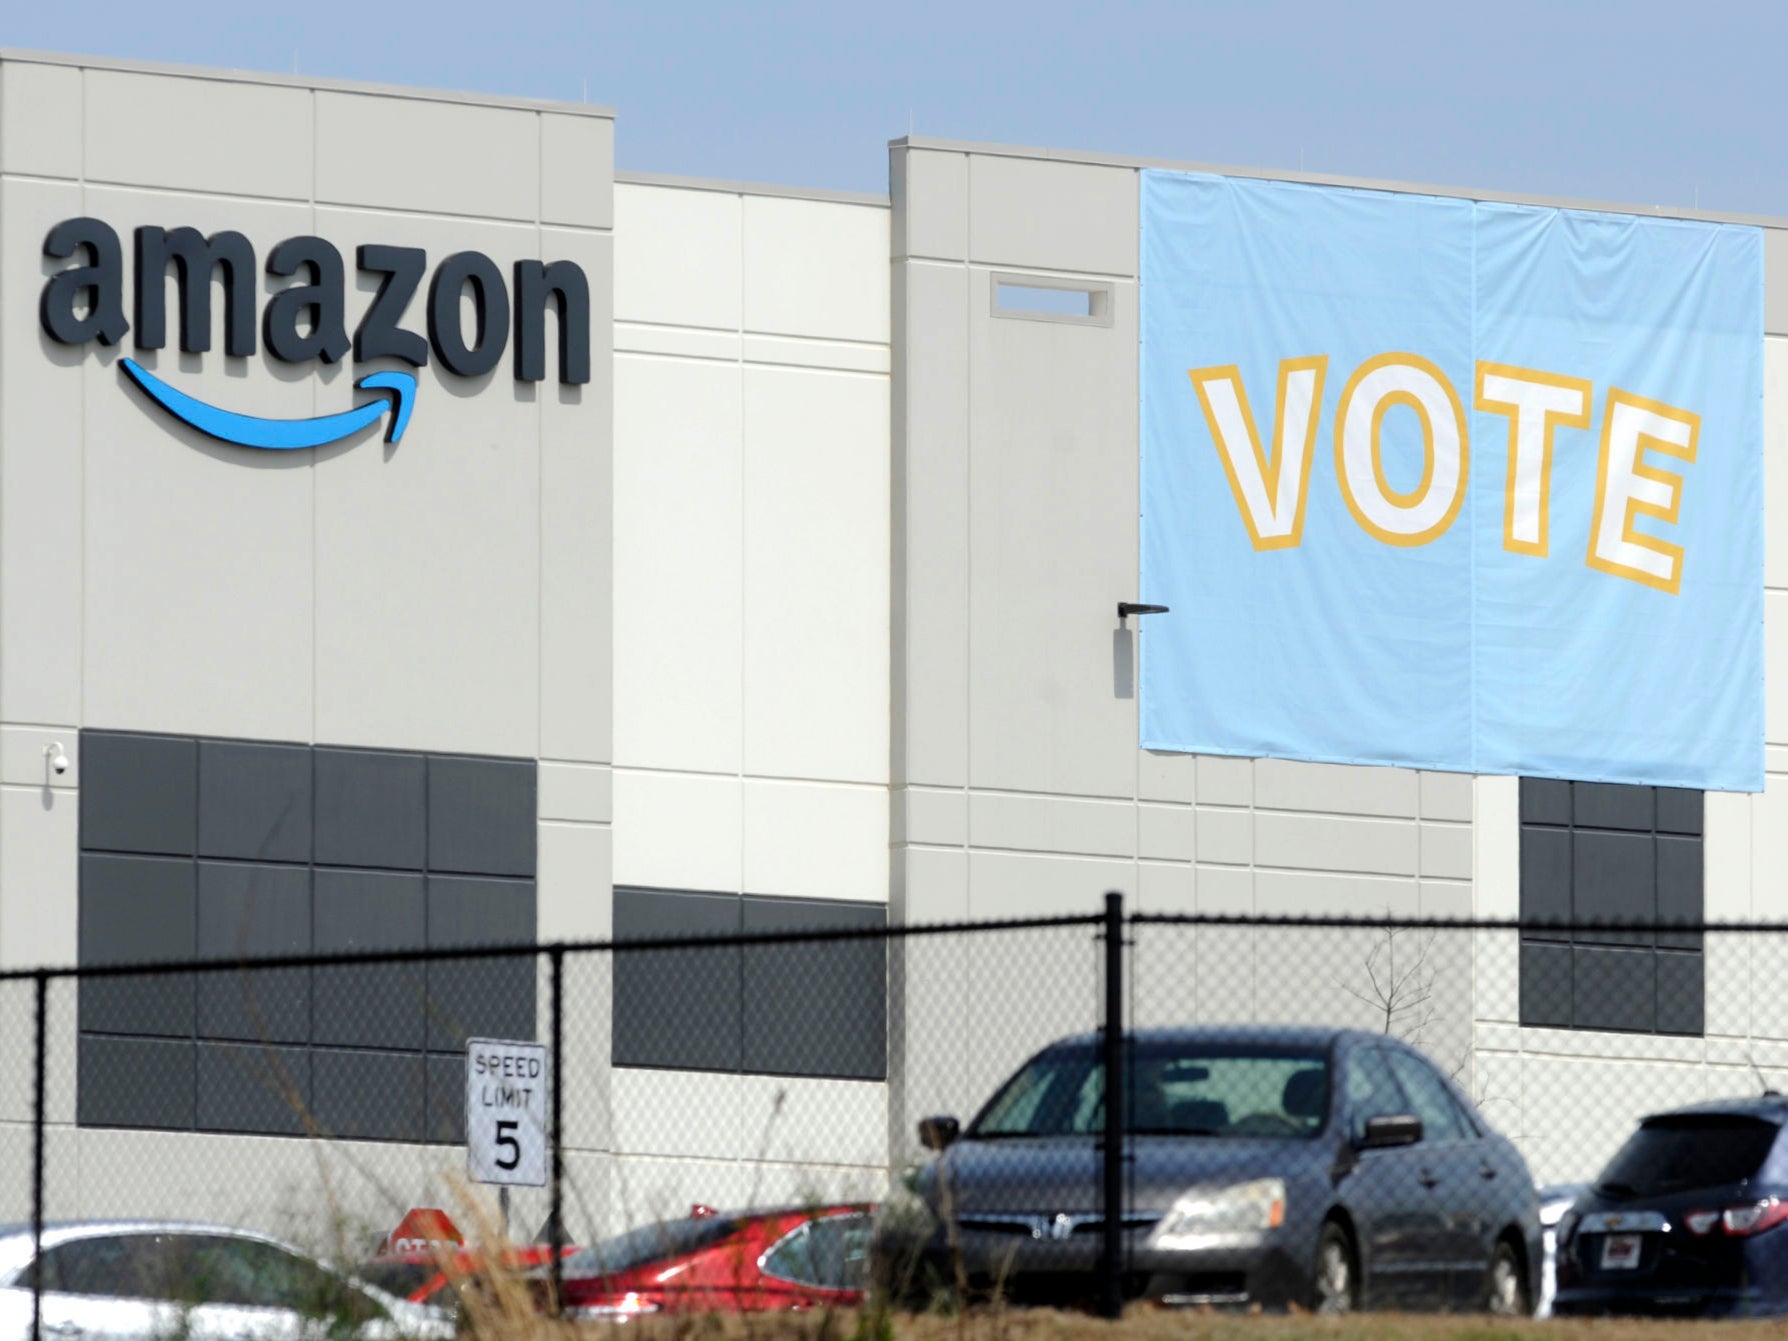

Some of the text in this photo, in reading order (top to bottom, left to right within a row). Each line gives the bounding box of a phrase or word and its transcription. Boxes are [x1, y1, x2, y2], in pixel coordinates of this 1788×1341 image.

[40, 217, 590, 384] amazon
[1188, 351, 1701, 595] VOTE
[475, 1055, 540, 1078] SPEED
[482, 1085, 532, 1110] LIMIT
[495, 1120, 520, 1171] 5
